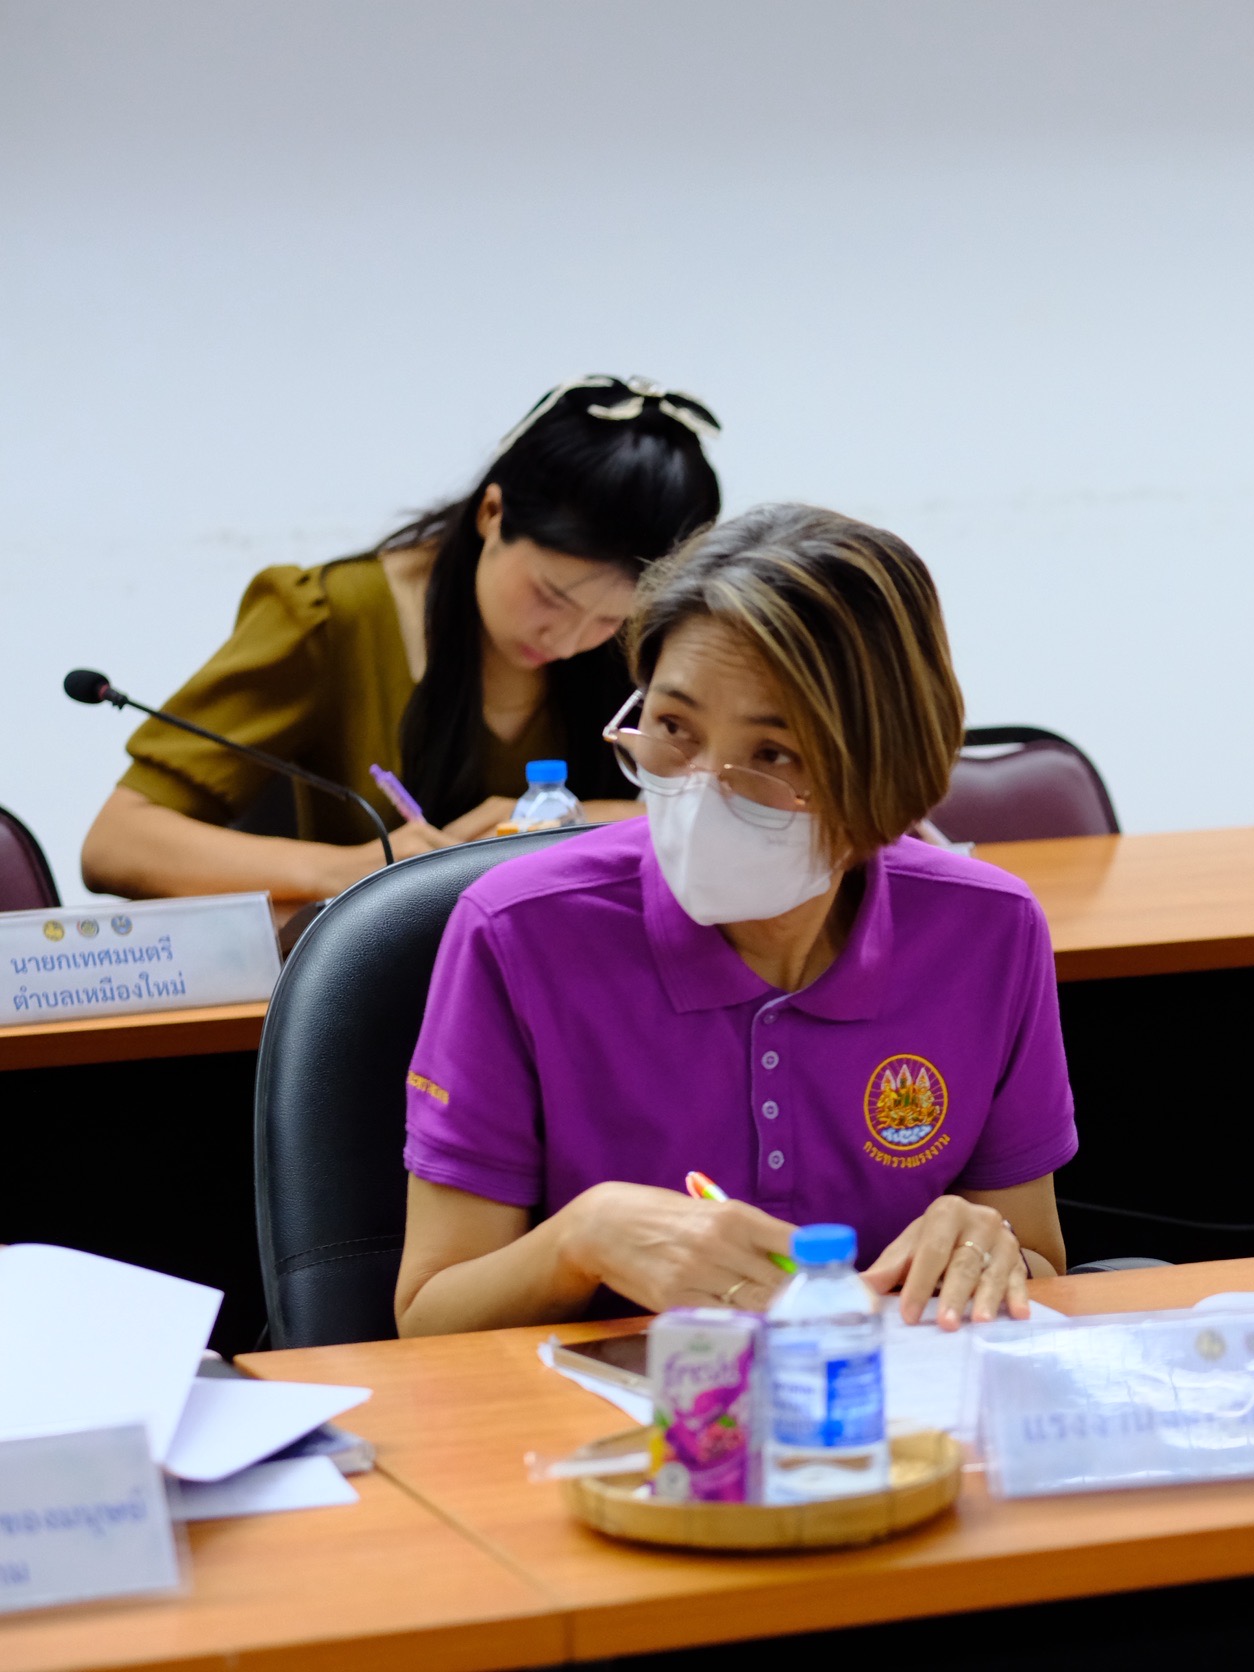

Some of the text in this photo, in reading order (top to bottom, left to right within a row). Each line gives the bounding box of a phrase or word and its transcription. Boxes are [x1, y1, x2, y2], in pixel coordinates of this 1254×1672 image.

[10, 935, 175, 975] นายกเทศมนตรี
[13, 972, 187, 1011] ตำบลเหมืองใหม่
[863, 1133, 951, 1168] กระทรวงแรงงาน
